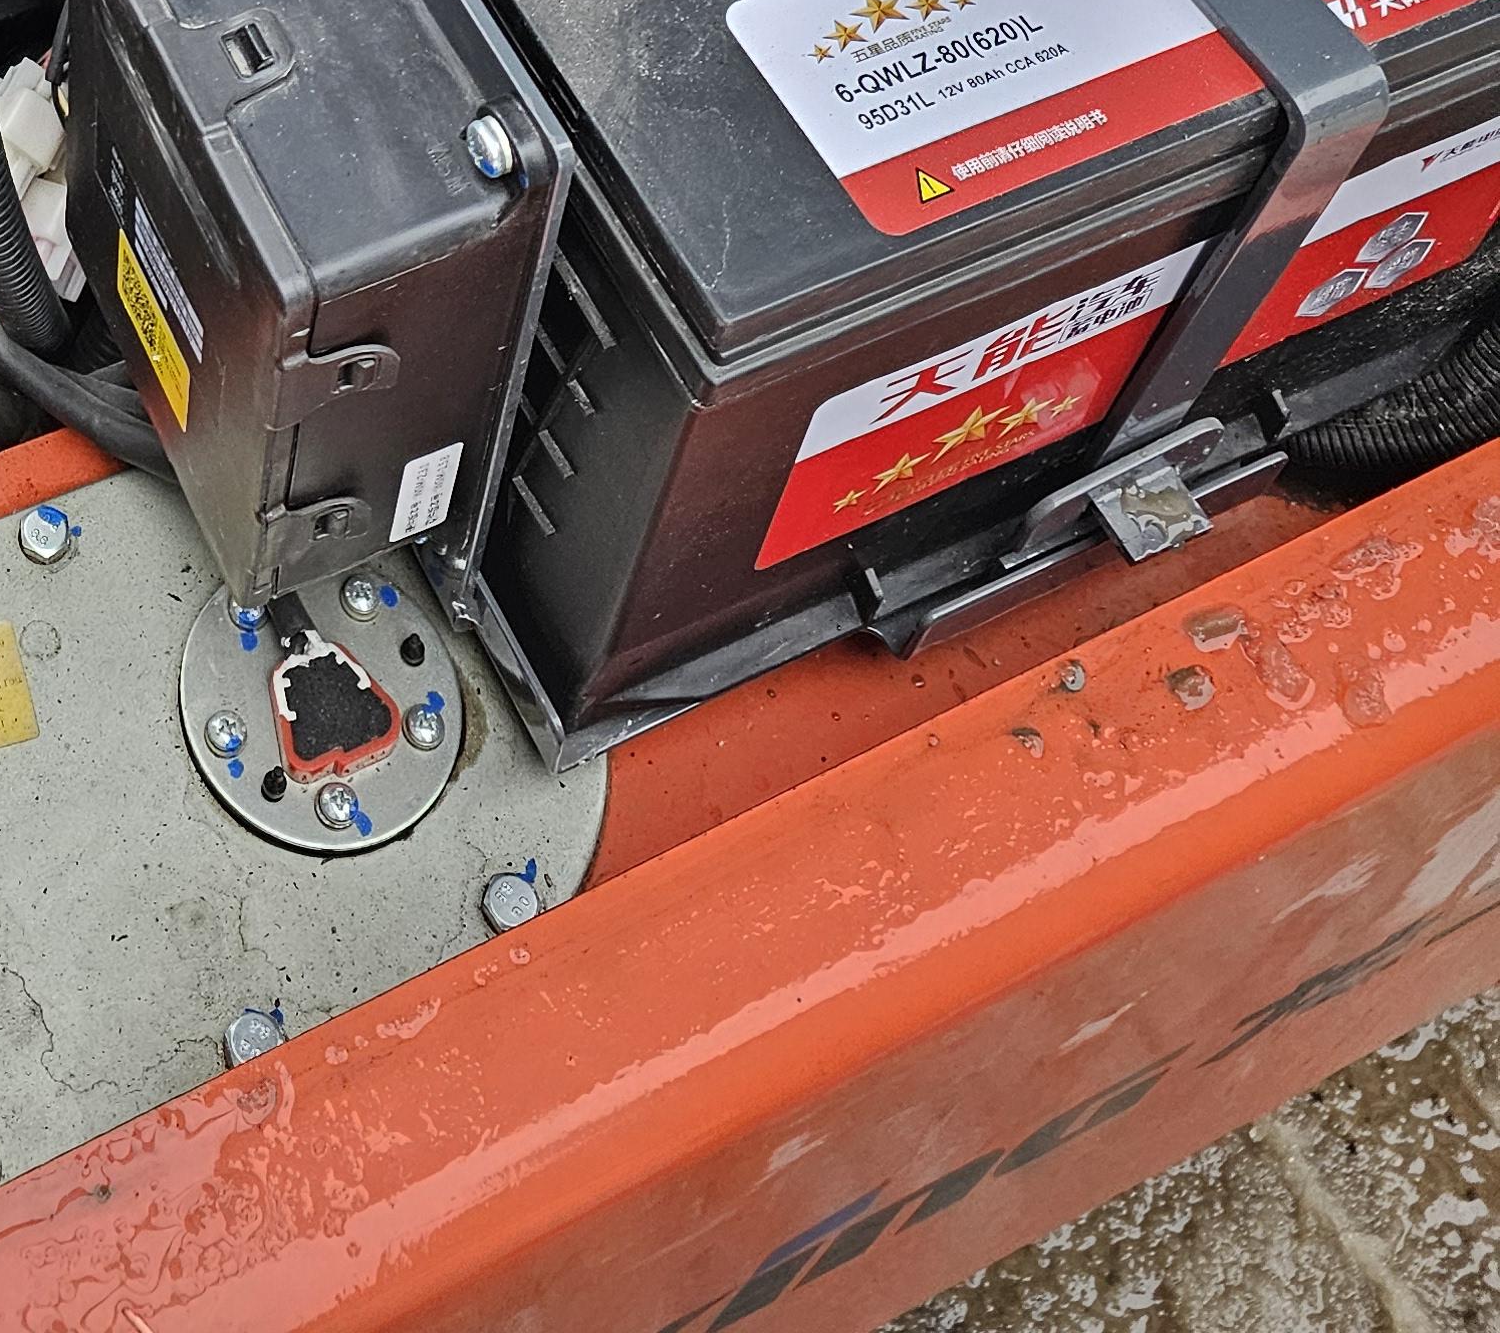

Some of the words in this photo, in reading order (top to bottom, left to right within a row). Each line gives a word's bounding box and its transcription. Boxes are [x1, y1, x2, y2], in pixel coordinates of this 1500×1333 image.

[835, 15, 1043, 103] 6-QWLZ-80(620)L
[851, 30, 914, 63] 五星品质
[858, 91, 936, 130] 95D31L
[938, 82, 964, 100] 12V
[966, 68, 1005, 89] 80Ah
[1005, 56, 1036, 75] CCA
[1035, 43, 1070, 63] 620A
[869, 304, 1074, 425] 天能
